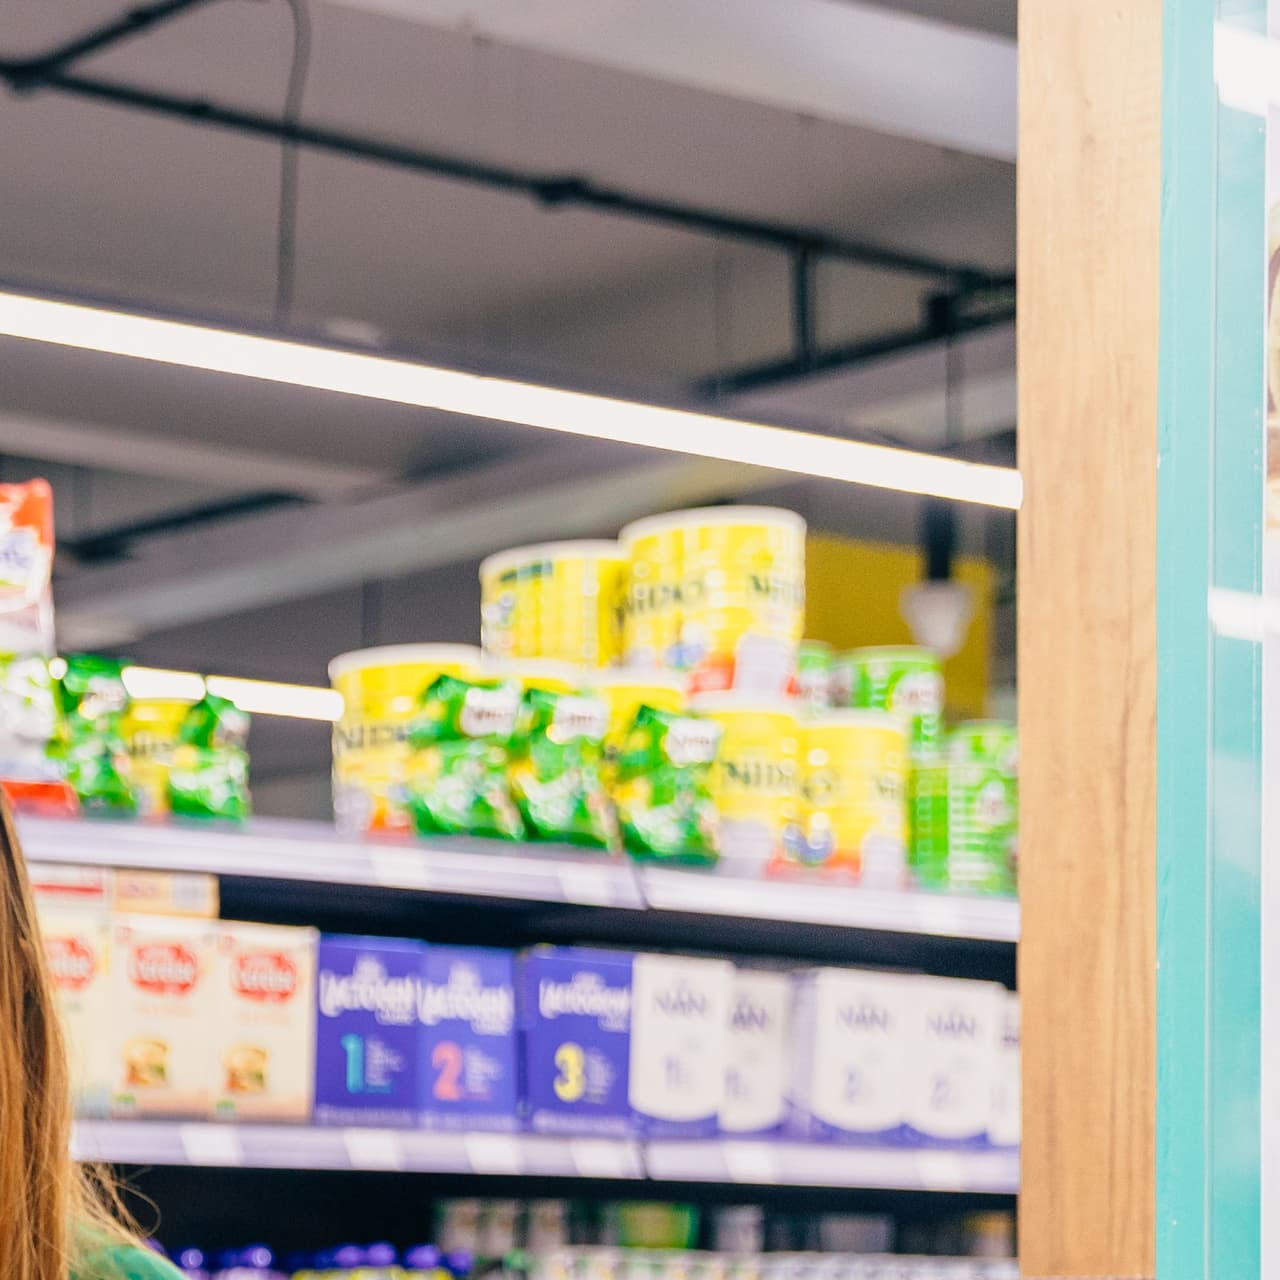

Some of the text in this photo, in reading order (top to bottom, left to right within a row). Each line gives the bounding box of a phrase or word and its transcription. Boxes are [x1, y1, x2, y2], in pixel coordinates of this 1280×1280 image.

[341, 1034, 364, 1093] 1
[431, 1041, 463, 1100] 2
[553, 1042, 586, 1101] 3
